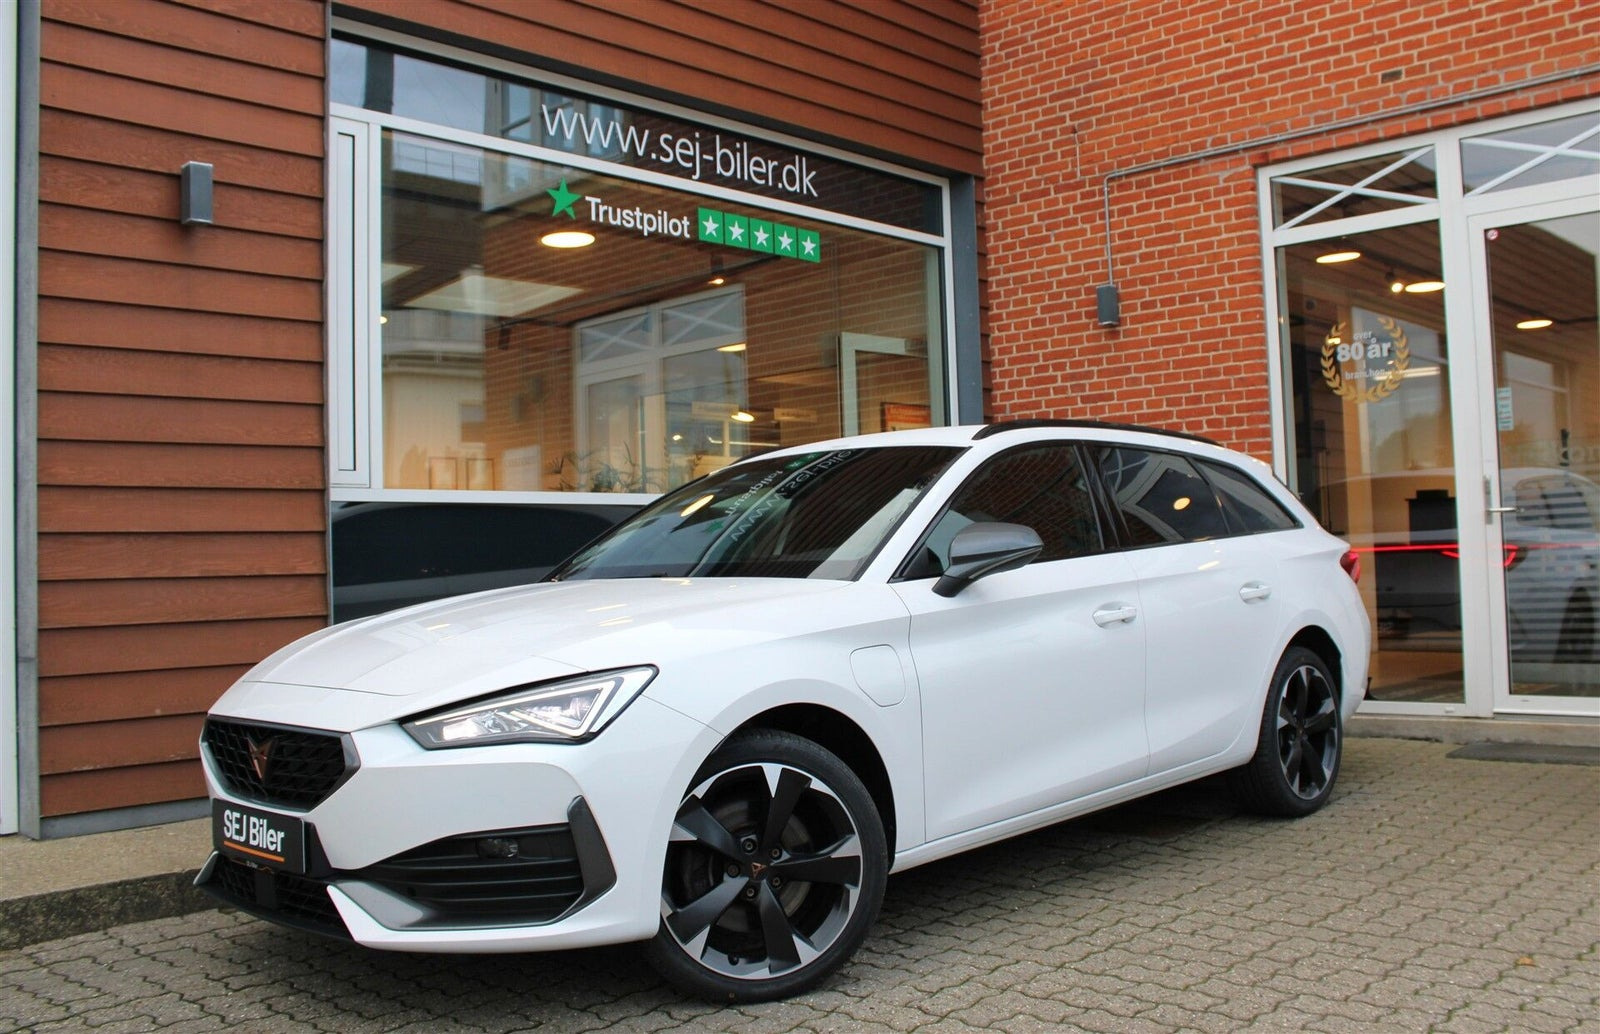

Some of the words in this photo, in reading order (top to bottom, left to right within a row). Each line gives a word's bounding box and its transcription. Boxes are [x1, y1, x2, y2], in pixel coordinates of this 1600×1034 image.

[542, 104, 818, 198] www.sej-biler.dk
[585, 196, 691, 238] Trustpilot
[1336, 342, 1364, 362] 80
[1367, 337, 1391, 359] år
[224, 809, 247, 842] SEJ
[249, 816, 285, 853] Biler
